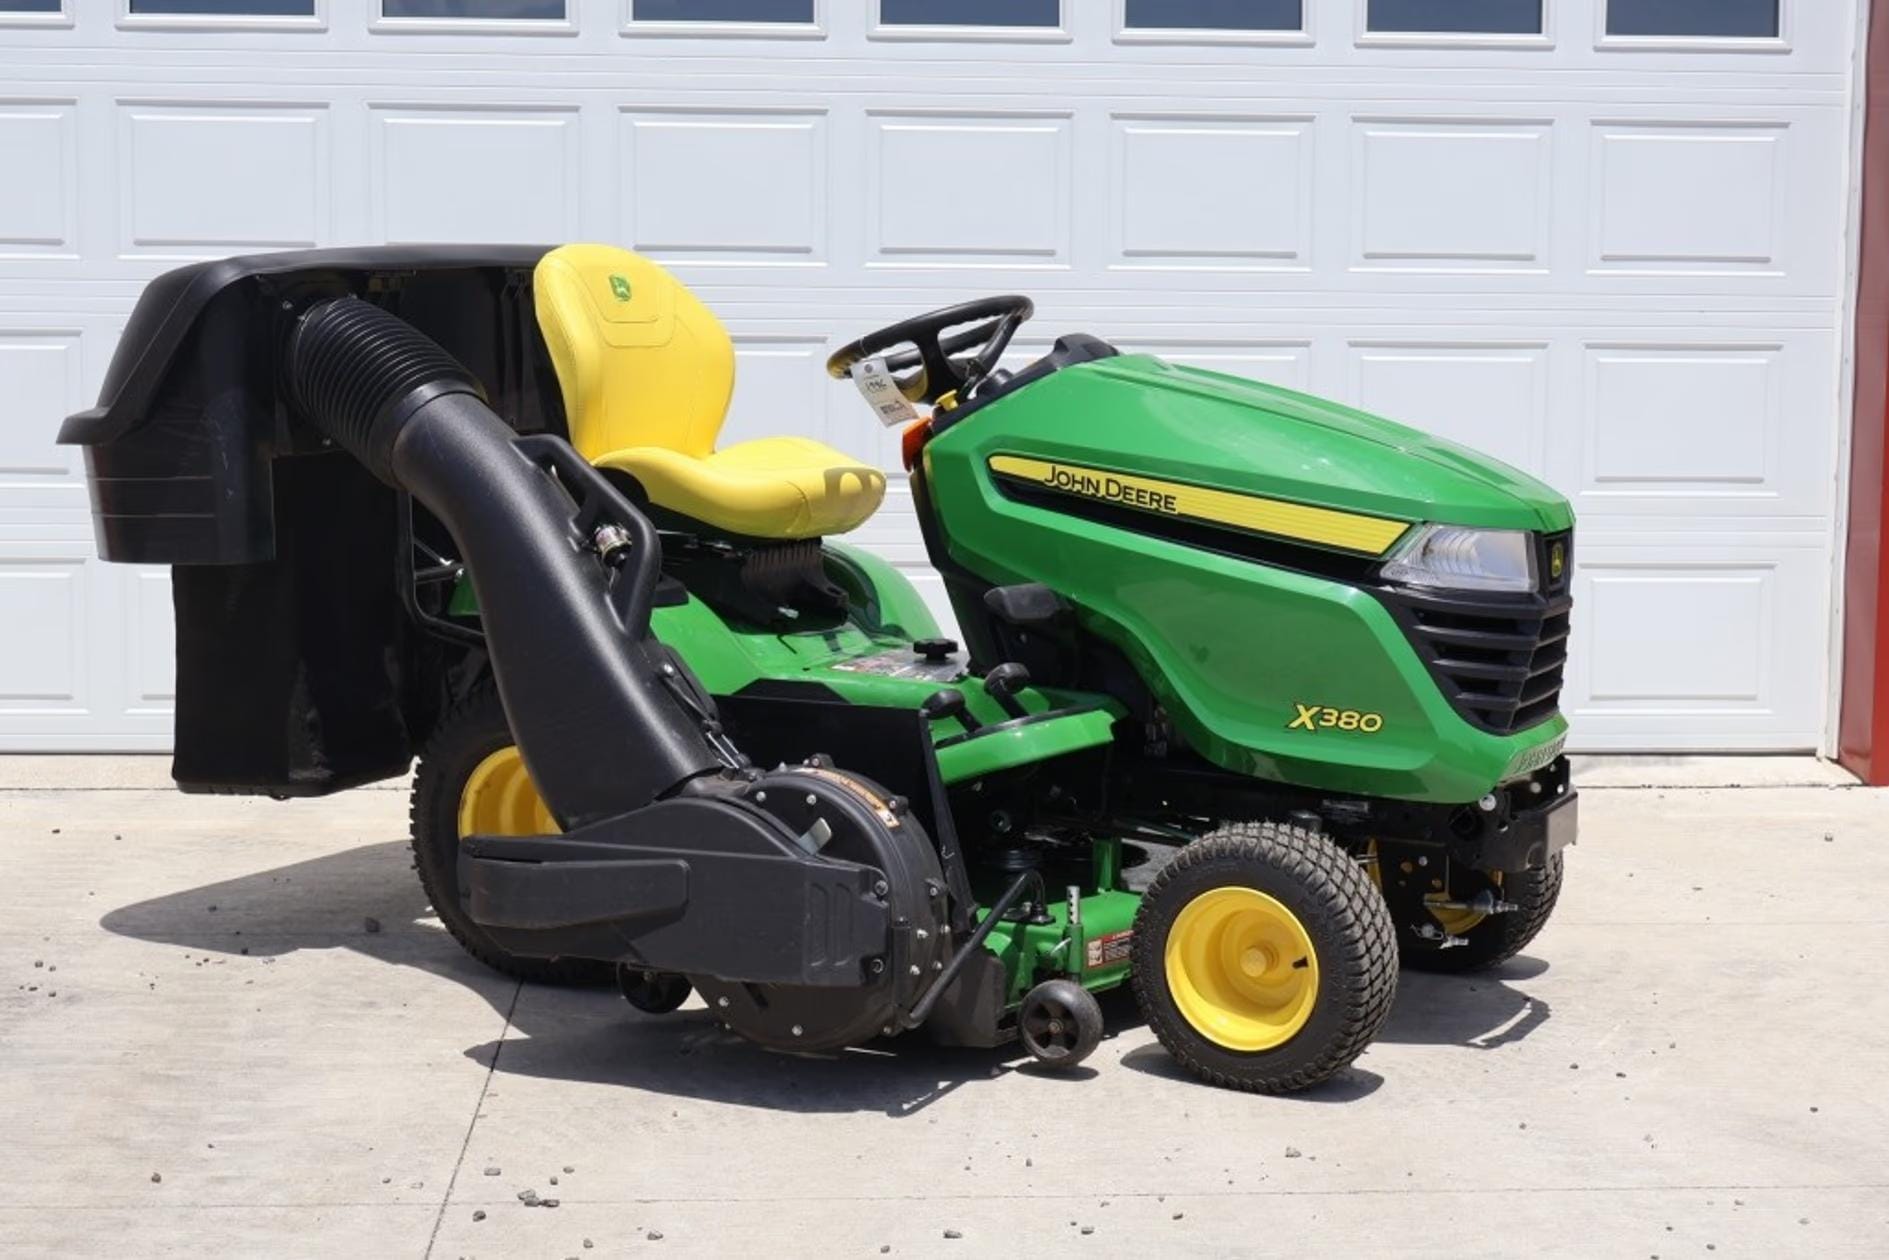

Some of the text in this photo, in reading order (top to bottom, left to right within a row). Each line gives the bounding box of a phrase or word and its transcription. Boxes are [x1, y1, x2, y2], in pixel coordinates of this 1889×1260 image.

[1044, 465, 1177, 512] JOHN DEERE
[1287, 703, 1383, 732] X380
